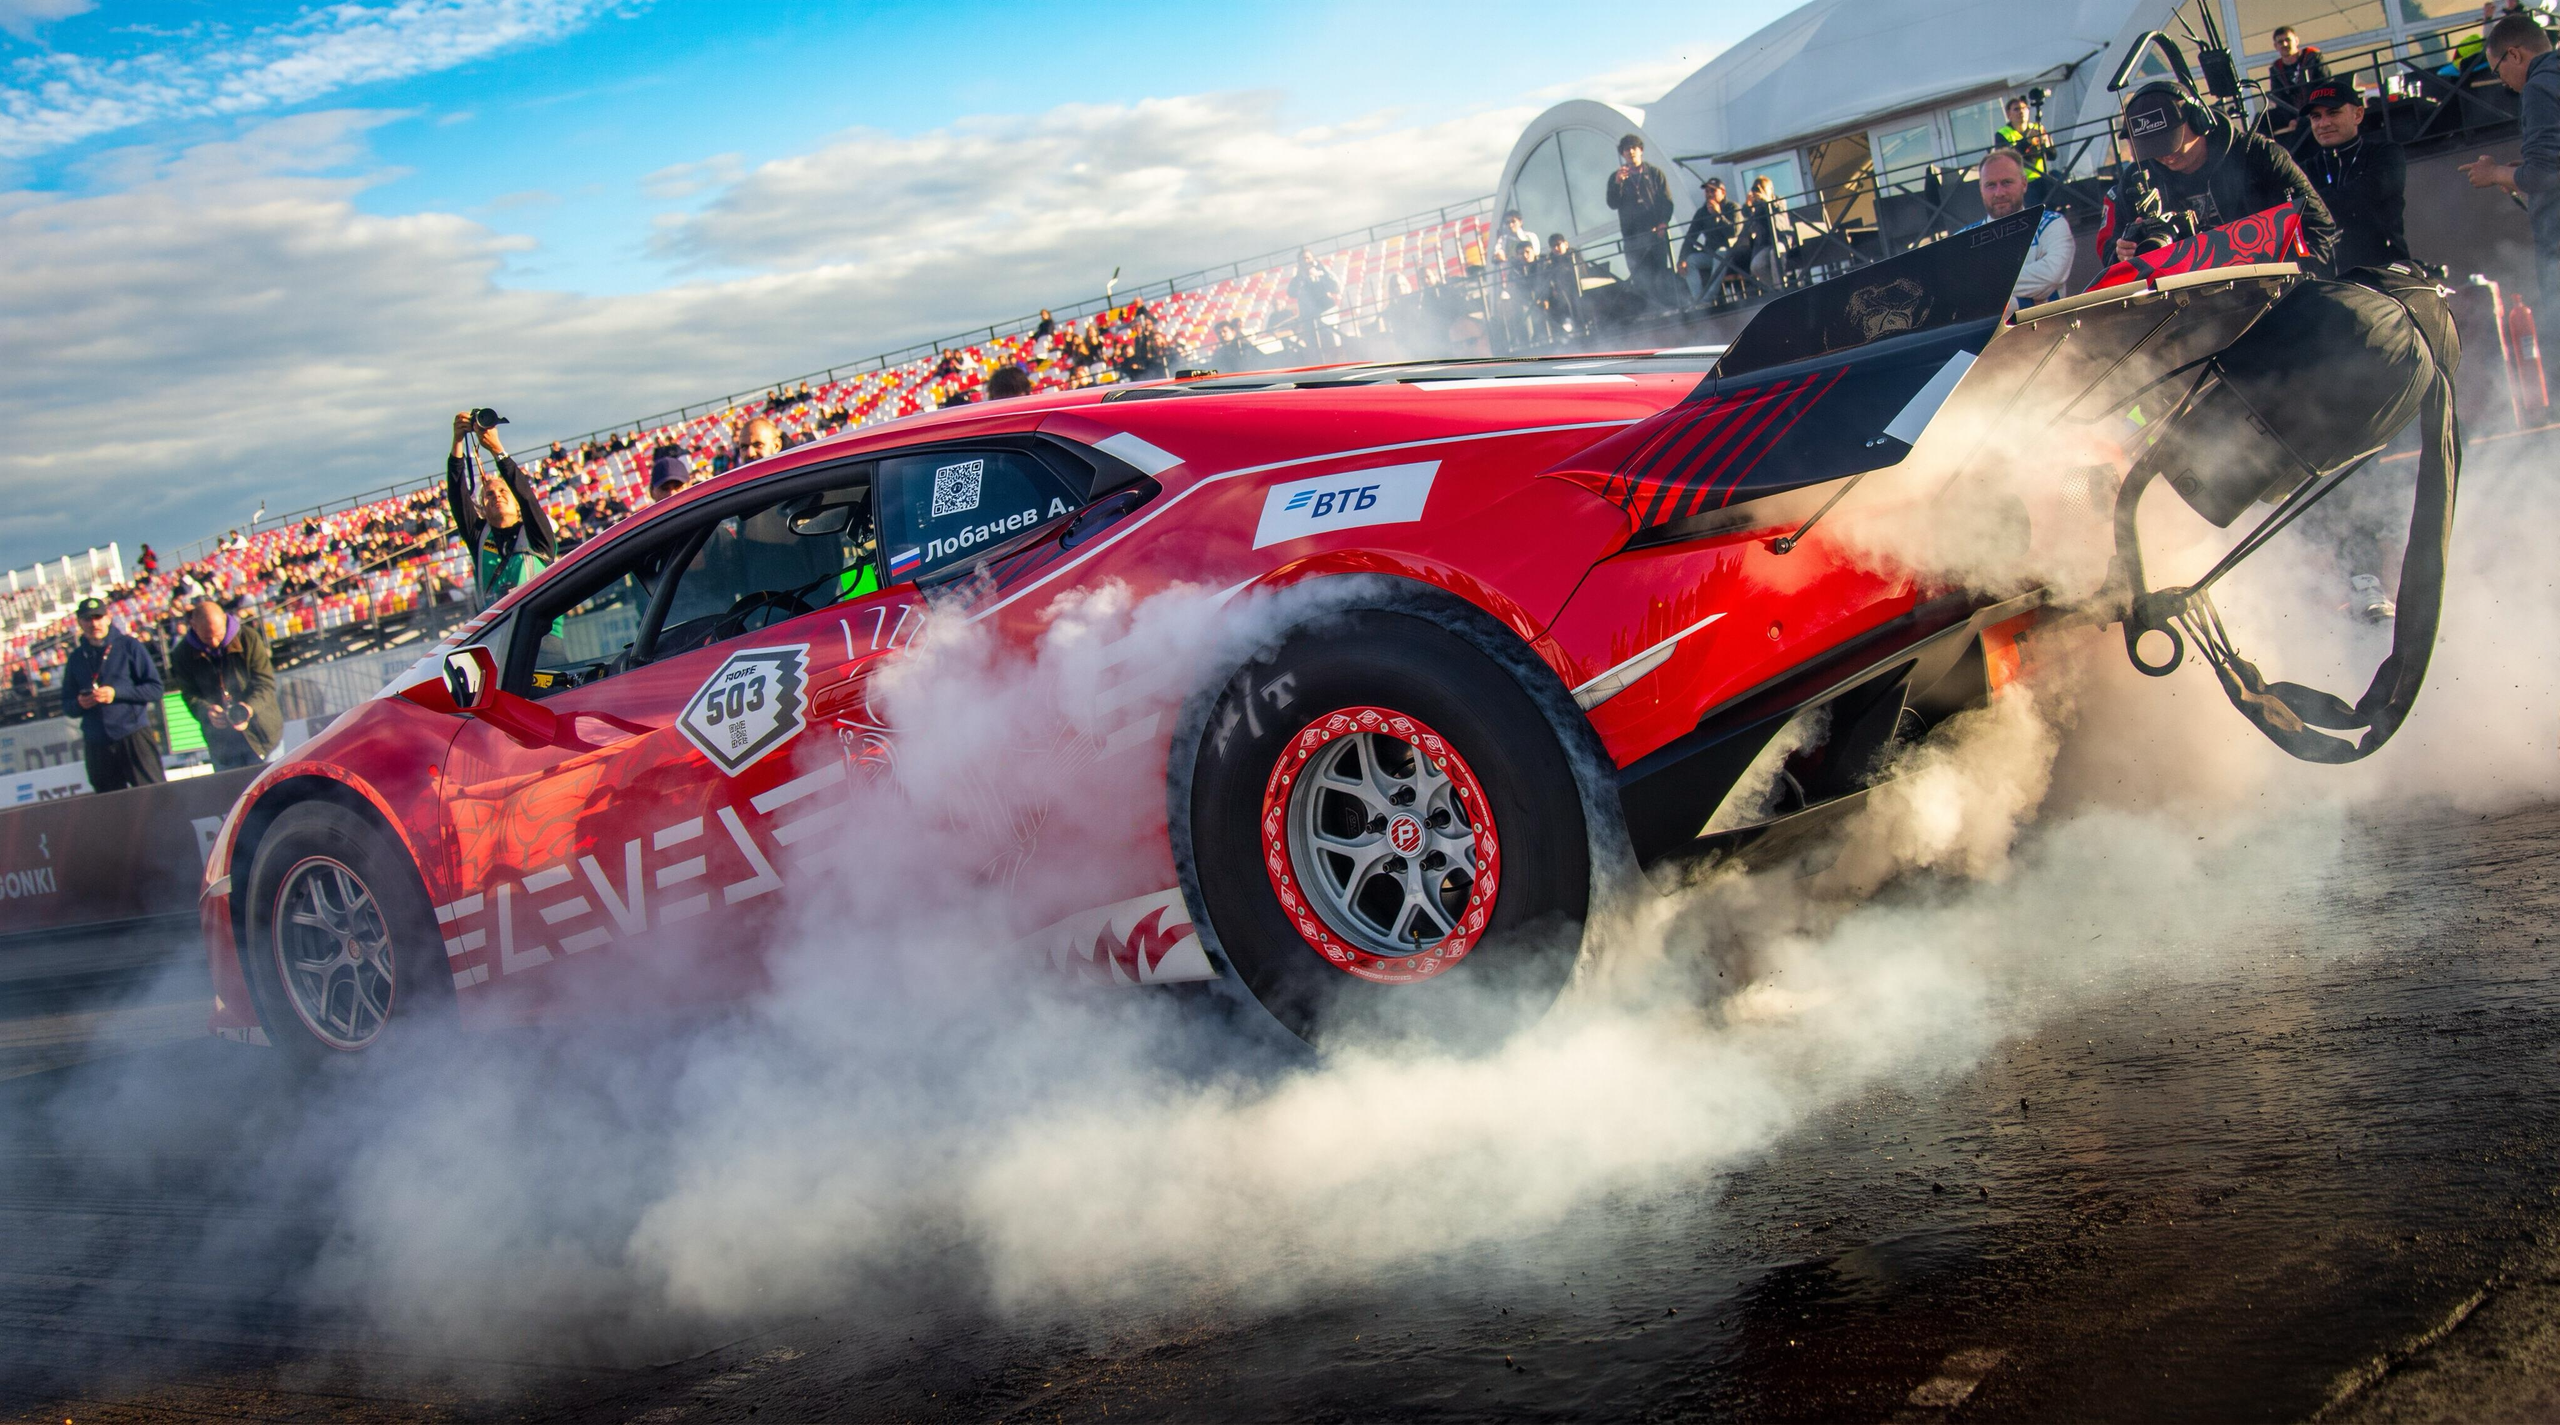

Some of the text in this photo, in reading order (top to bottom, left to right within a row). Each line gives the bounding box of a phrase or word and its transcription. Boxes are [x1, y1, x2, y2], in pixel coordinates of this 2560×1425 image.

[1311, 484, 1381, 518] ВТБ
[925, 497, 1075, 563] Лобачев А.
[706, 675, 767, 726] 503
